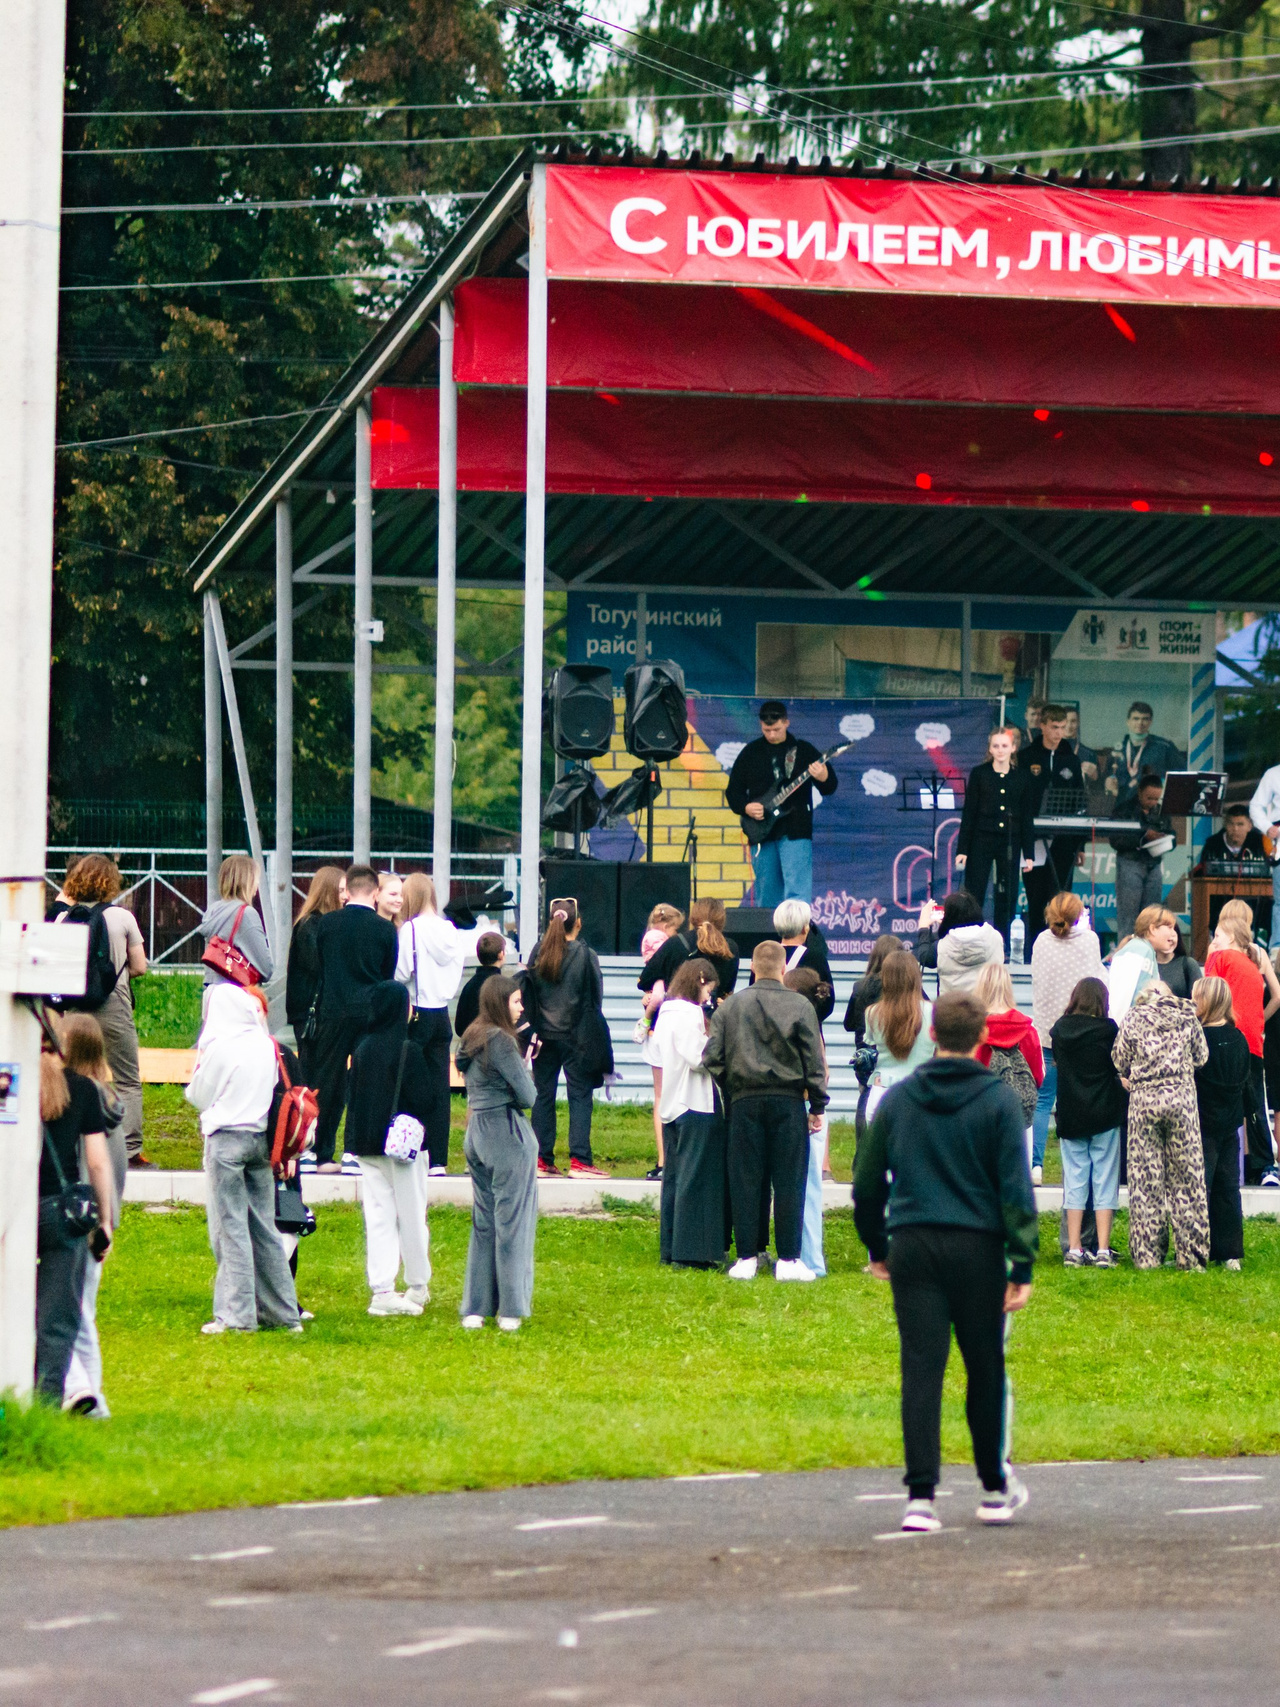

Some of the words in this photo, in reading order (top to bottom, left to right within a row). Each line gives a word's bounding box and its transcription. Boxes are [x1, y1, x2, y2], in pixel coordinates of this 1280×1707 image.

[608, 196, 668, 255] С
[686, 214, 1011, 281] ЮБИЛЕЕМ,
[1159, 633, 1201, 643] НОРМА
[1159, 644, 1200, 655] ЖИЗНИ
